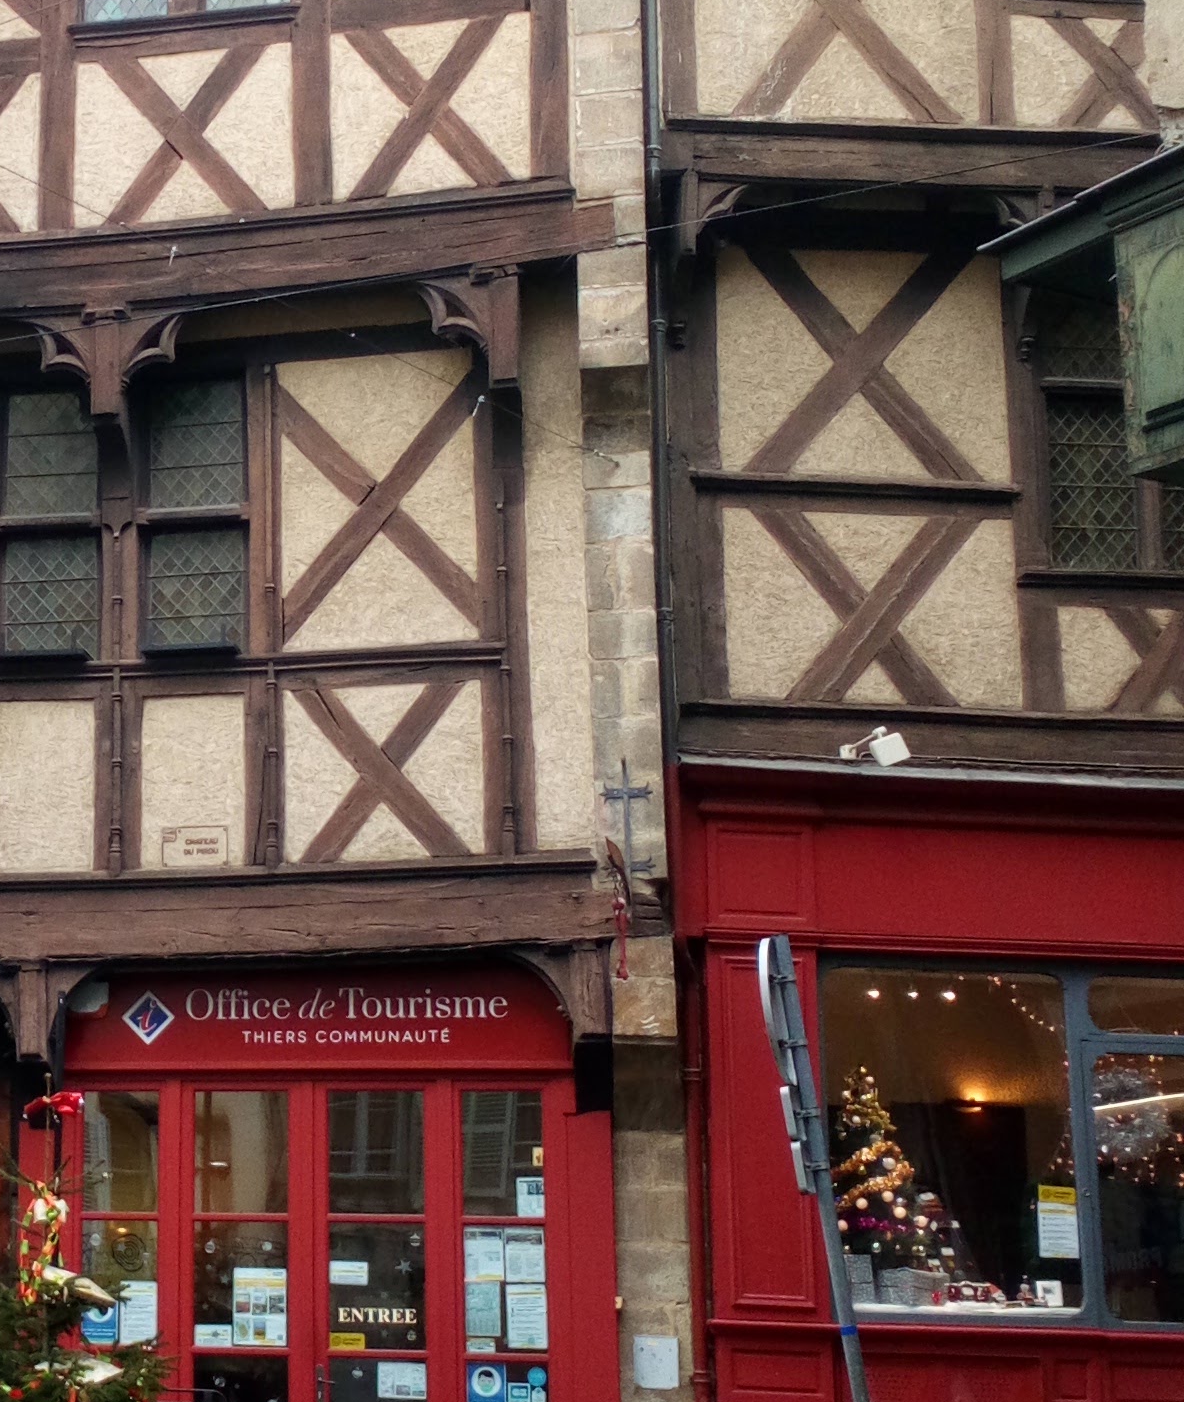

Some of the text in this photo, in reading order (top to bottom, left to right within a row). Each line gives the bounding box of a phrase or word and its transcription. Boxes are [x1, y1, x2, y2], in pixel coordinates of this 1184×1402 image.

[185, 987, 509, 1021] Office de Tourisme
[241, 1027, 451, 1044] THIERS COMMUNAUTÉ
[337, 1307, 417, 1324] ENTREE
